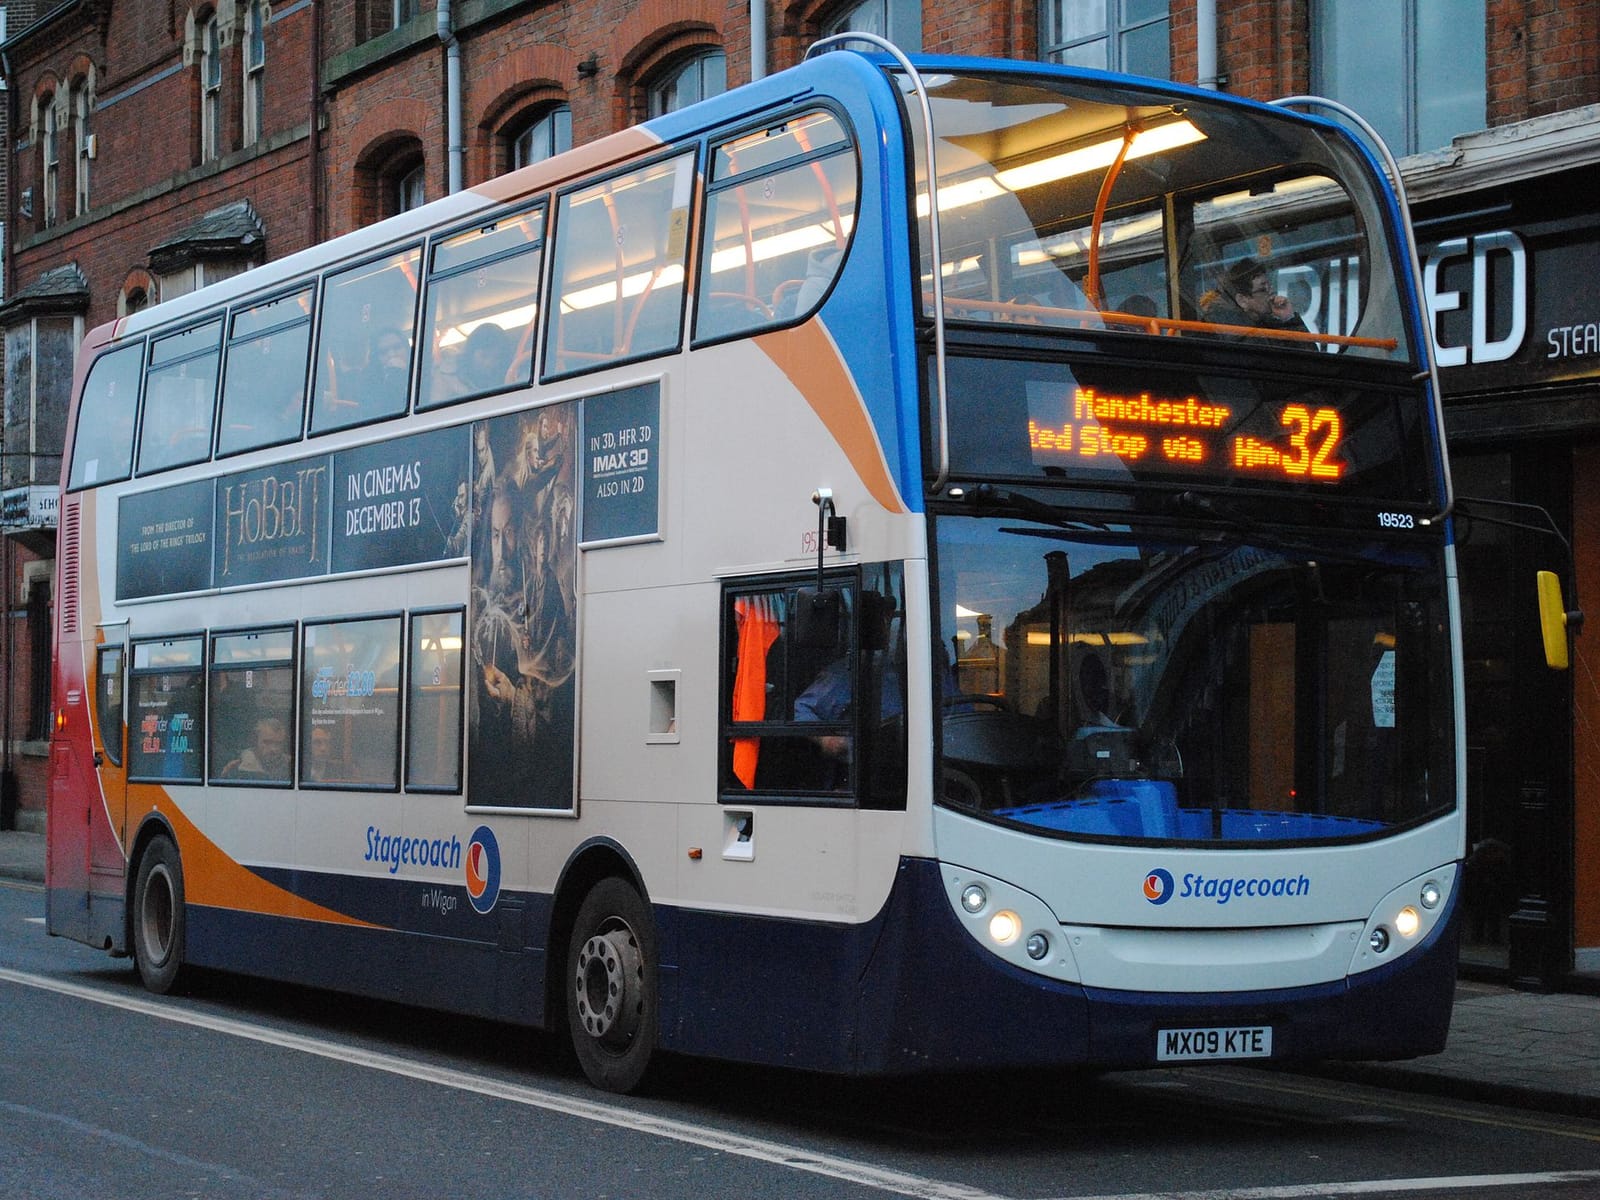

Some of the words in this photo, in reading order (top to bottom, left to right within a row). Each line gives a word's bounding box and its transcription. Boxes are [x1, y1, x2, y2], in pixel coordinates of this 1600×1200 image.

[1547, 323, 1600, 358] STEA
[1075, 389, 1230, 427] Manchester
[591, 437, 600, 451] IN
[619, 428, 637, 446] HFR
[639, 425, 652, 442] 3D
[1079, 425, 1148, 459] Stop
[1163, 436, 1203, 461] via
[1282, 406, 1339, 477] 32
[593, 452, 628, 473] IMAX
[630, 448, 648, 467] 3D
[347, 472, 360, 502] IN
[363, 461, 421, 498] CINEMAS
[596, 481, 618, 498] ALSO
[620, 480, 630, 494] IN
[632, 476, 644, 493] 2D
[346, 500, 406, 536] DECEMBER
[409, 497, 422, 527] 13
[1377, 512, 1414, 528] 19523
[364, 825, 461, 875] Stagecoach
[421, 889, 430, 907] in
[431, 888, 457, 916] Wigan
[1180, 873, 1310, 905] Stagecoach
[1166, 1031, 1219, 1055] MX09
[1225, 1029, 1264, 1053] KTE
